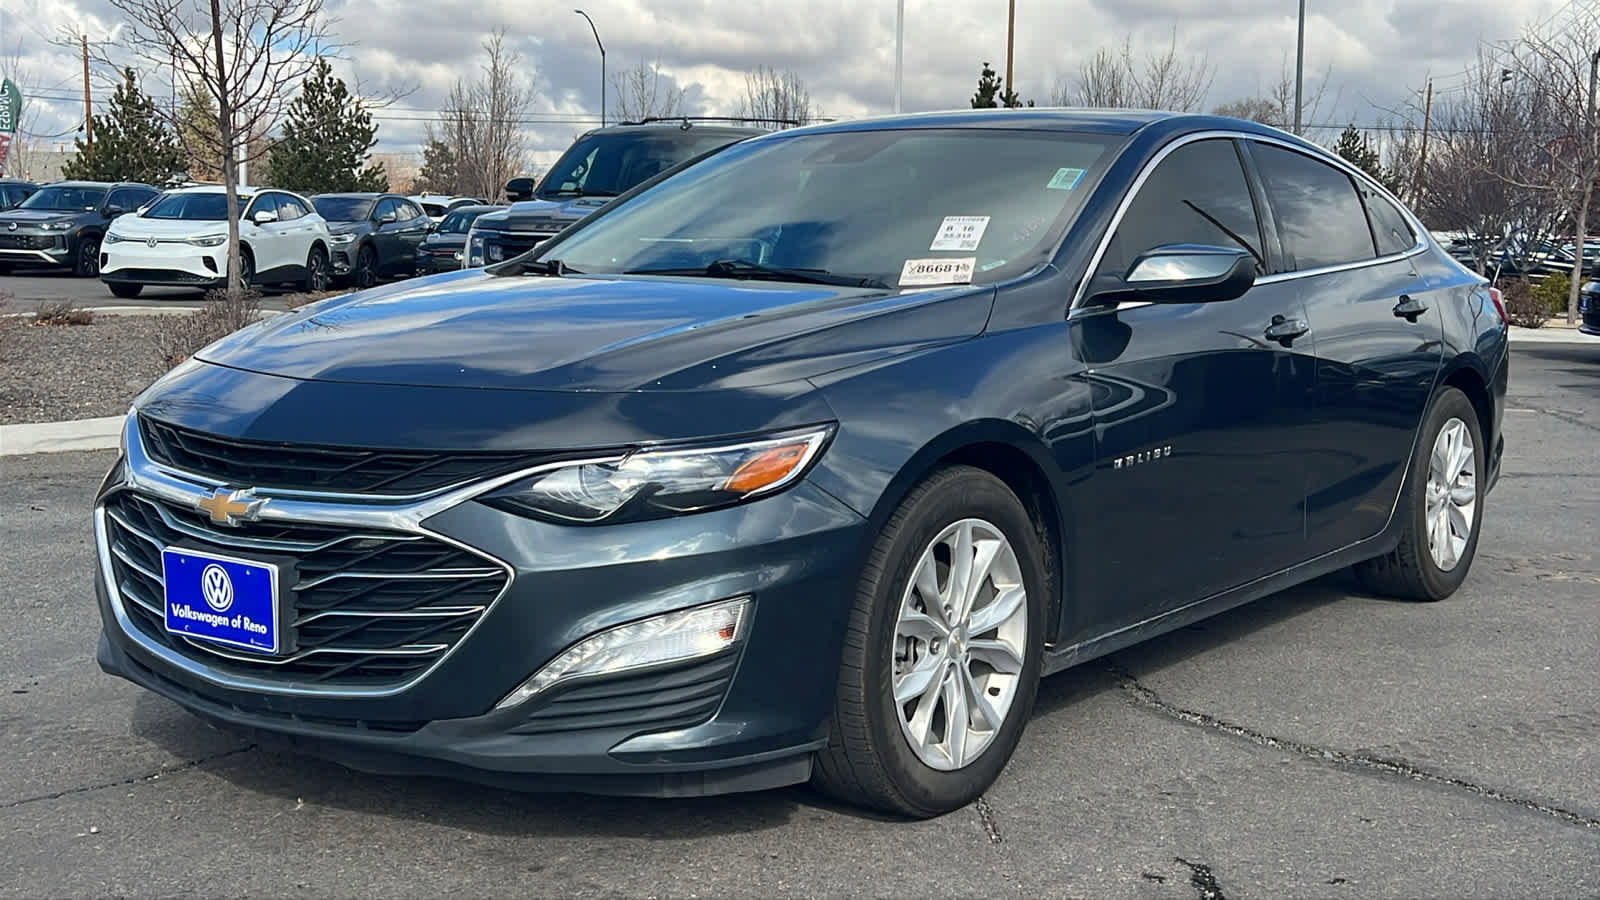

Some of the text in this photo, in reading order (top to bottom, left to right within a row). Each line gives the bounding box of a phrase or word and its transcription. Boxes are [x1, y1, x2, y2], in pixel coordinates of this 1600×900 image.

[171, 602, 268, 634] Volkswagen of Reno
